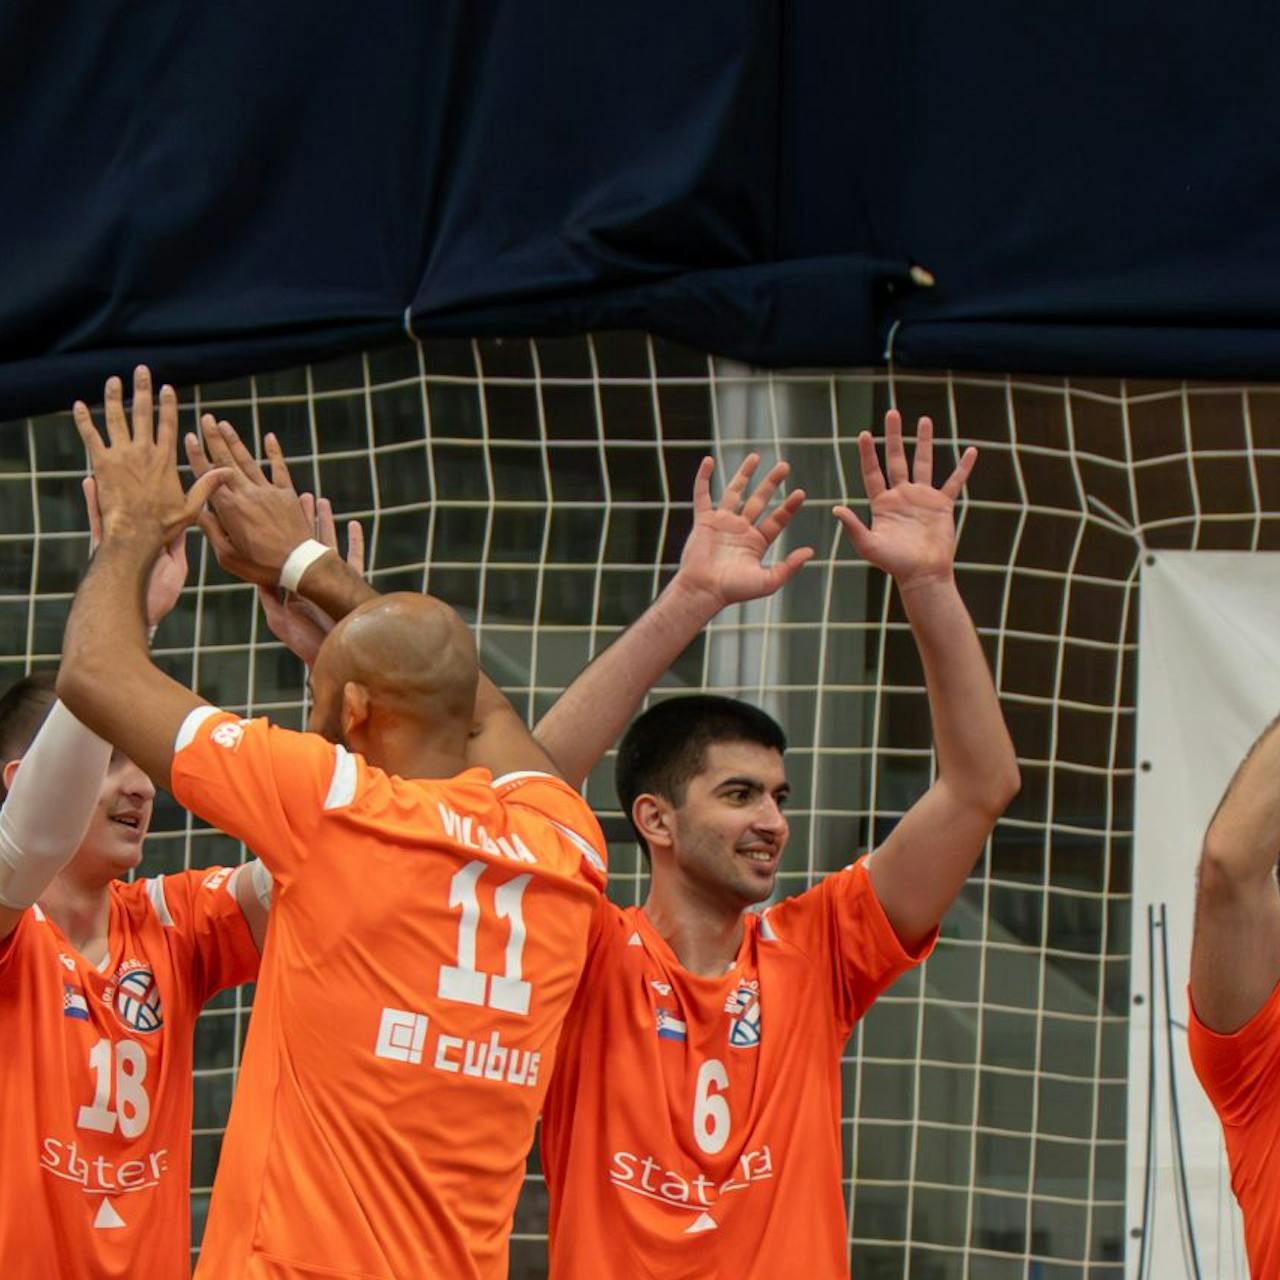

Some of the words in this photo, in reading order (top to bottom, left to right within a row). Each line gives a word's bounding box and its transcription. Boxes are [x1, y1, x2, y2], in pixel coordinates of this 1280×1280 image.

[437, 859, 534, 1016] 11
[76, 1038, 151, 1139] 18
[434, 1030, 542, 1087] cubus
[693, 1059, 731, 1155] 6
